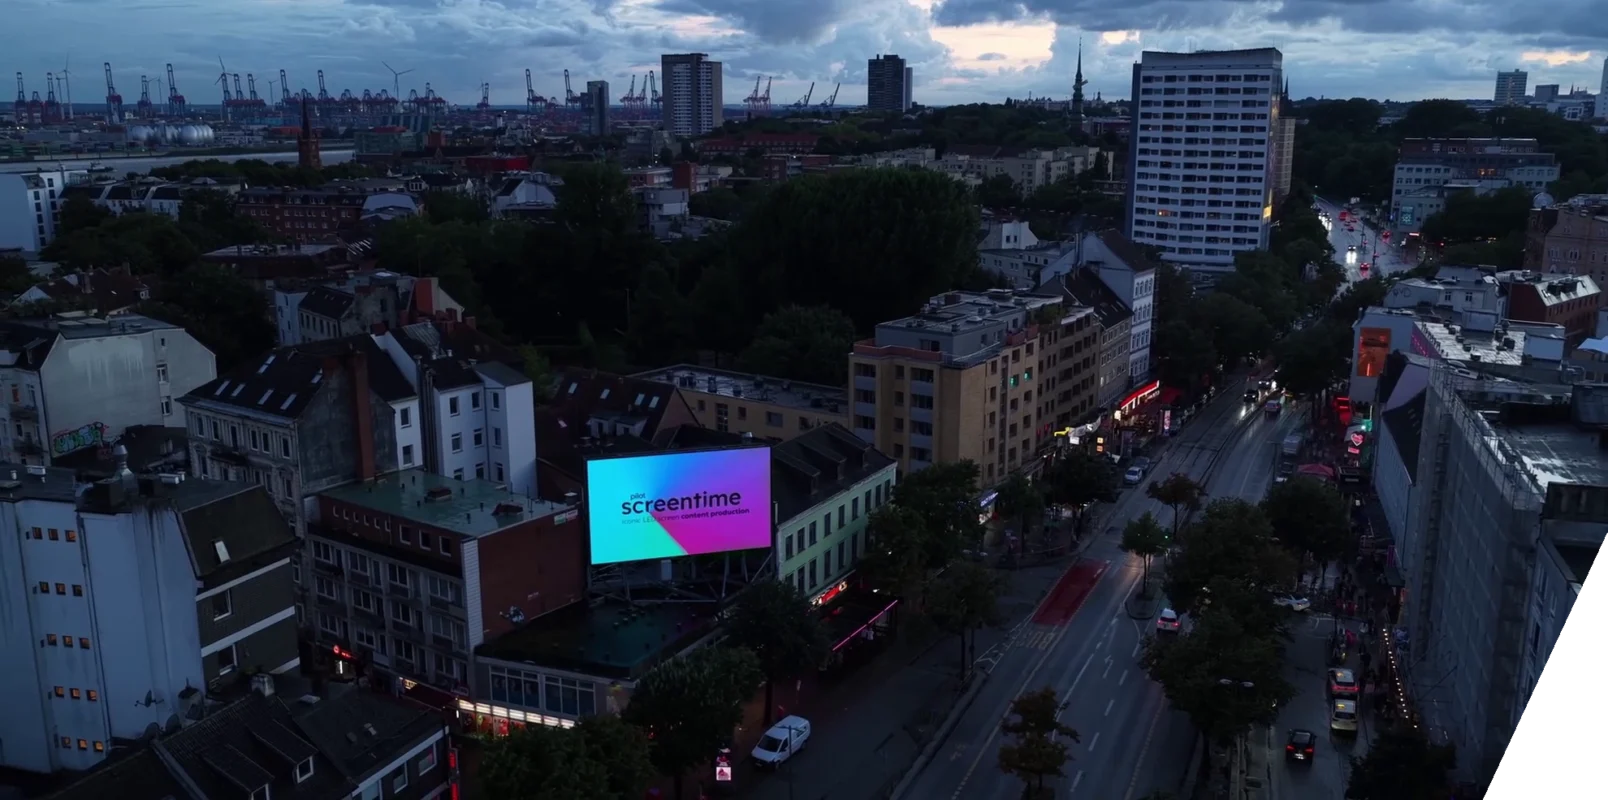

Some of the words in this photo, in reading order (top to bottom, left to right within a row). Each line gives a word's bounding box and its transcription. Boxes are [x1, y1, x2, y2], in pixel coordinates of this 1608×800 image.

[621, 491, 741, 515] screentime
[630, 492, 646, 500] pilot
[643, 516, 657, 524] LED
[658, 513, 680, 522] screen
[681, 511, 710, 520] content
[710, 508, 750, 518] production
